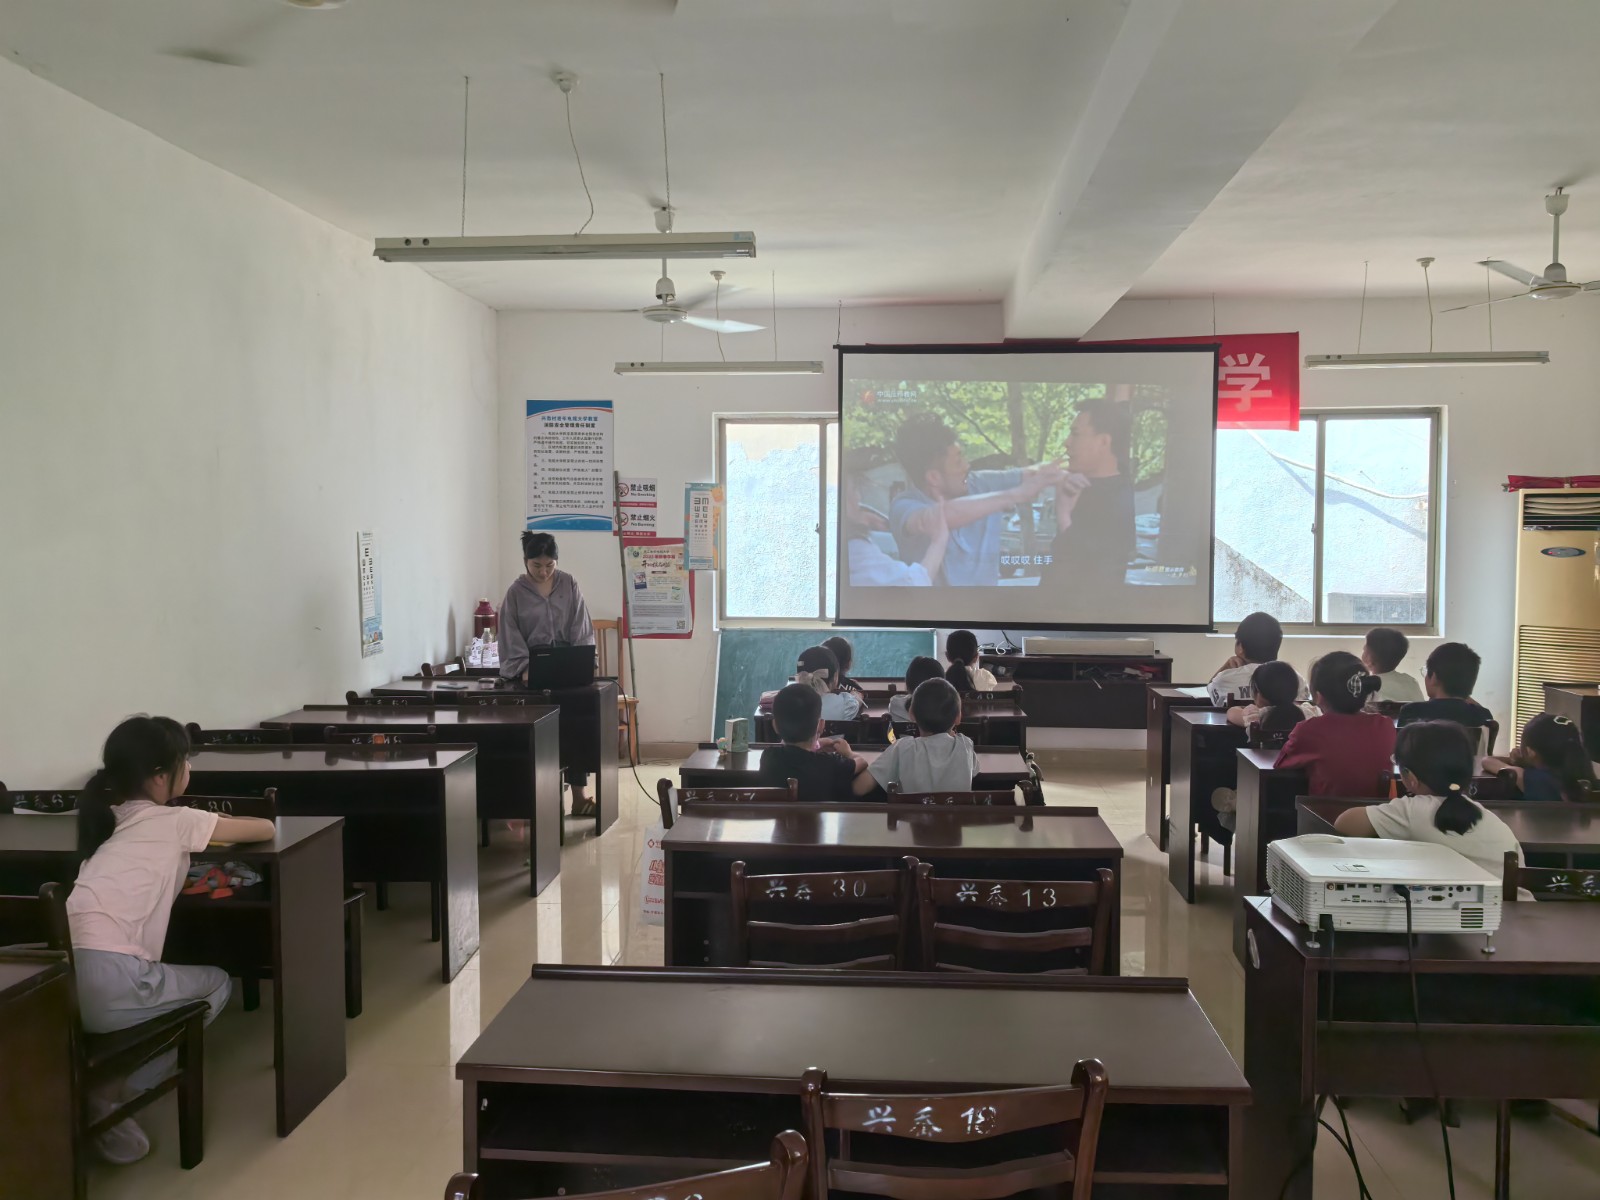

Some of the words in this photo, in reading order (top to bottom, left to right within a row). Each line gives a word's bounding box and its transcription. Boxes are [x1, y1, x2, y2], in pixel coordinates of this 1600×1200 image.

[1218, 353, 1273, 412] 学
[630, 484, 656, 492] 禁止吸烟
[630, 514, 656, 522] 禁止烟火
[1034, 555, 1053, 565] 住手
[833, 878, 867, 897] 30
[1022, 888, 1057, 907] 13
